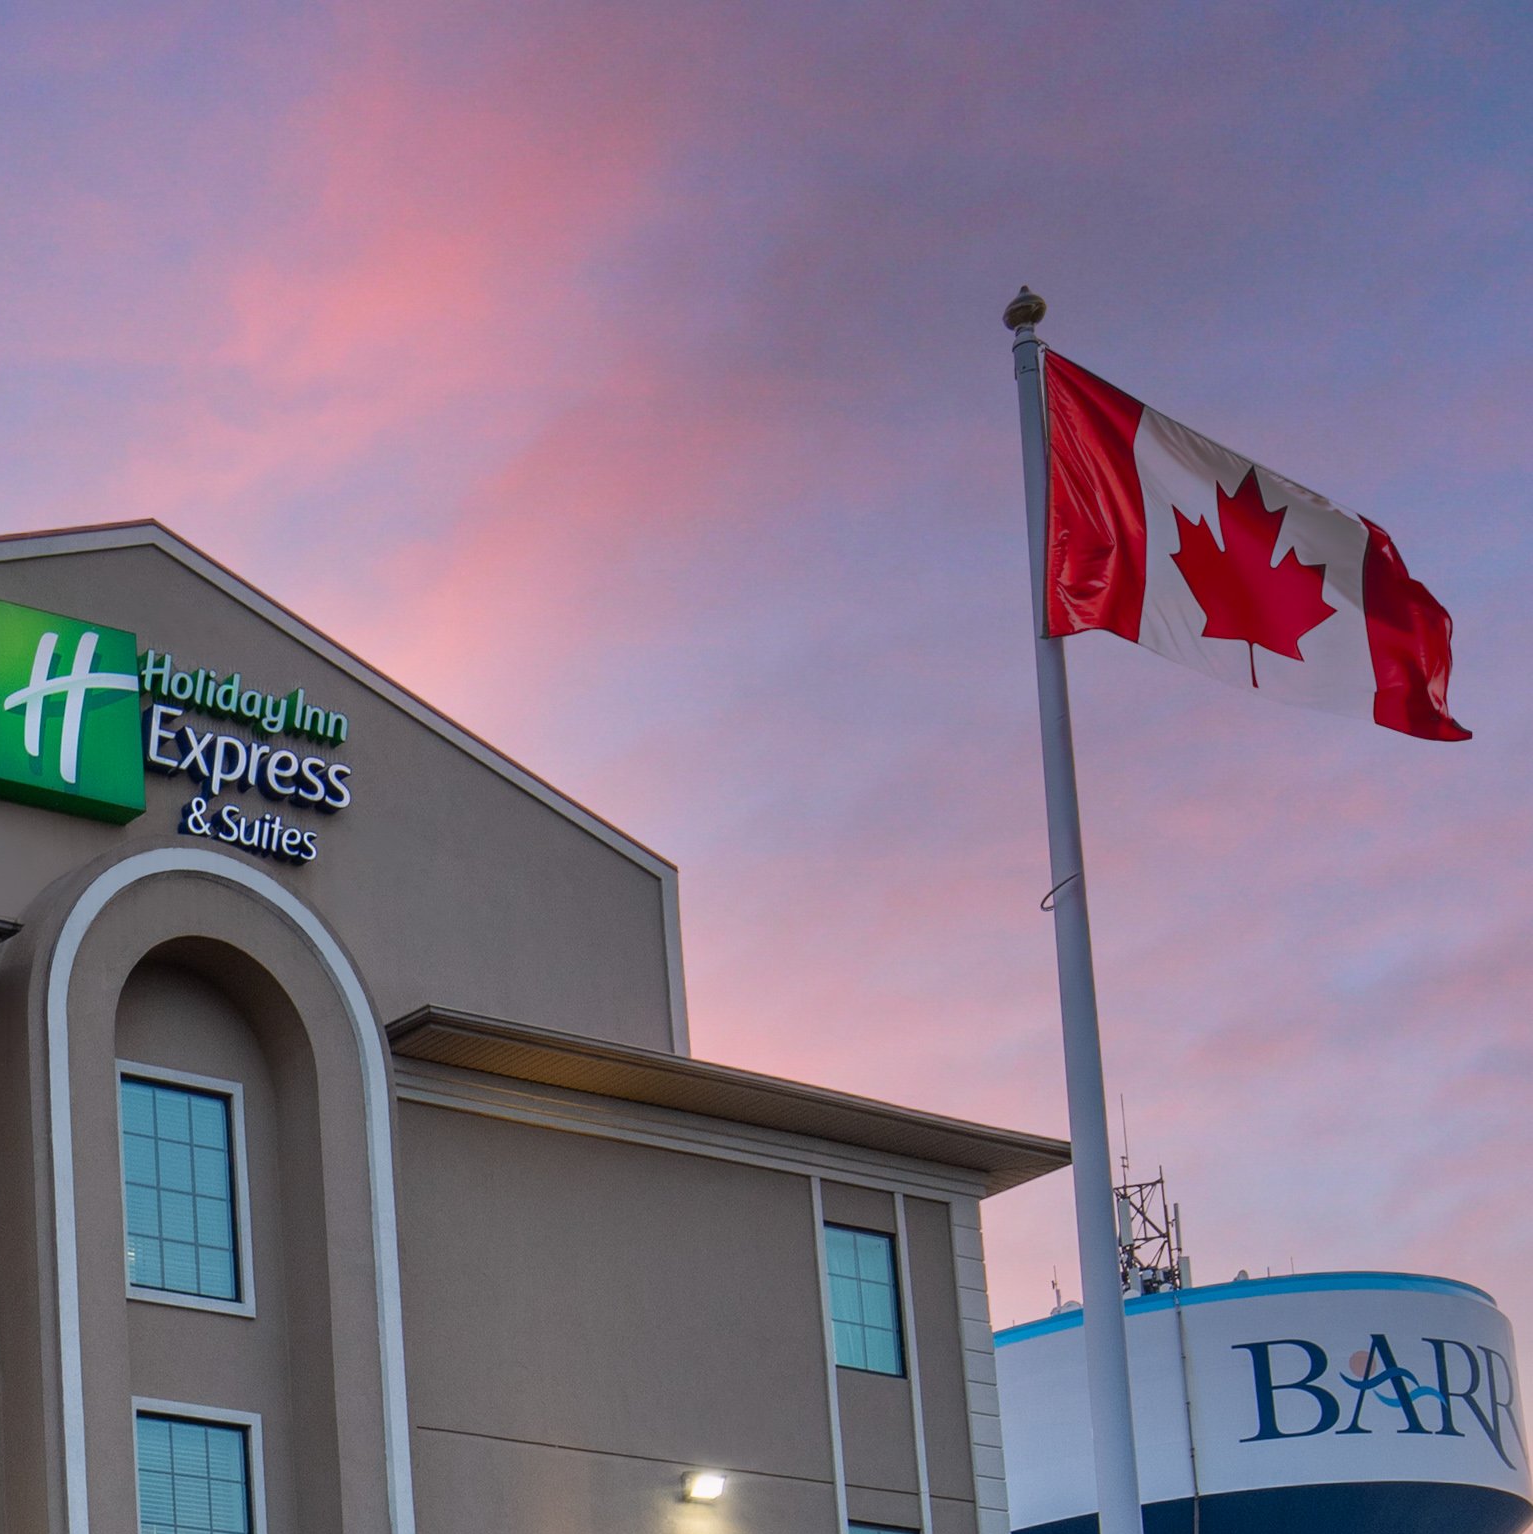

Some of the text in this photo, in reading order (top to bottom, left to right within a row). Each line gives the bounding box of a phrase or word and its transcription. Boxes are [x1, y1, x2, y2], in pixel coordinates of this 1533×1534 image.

[141, 648, 349, 743] Holiday Inn
[148, 703, 352, 809] Express
[187, 797, 318, 861] & Suites
